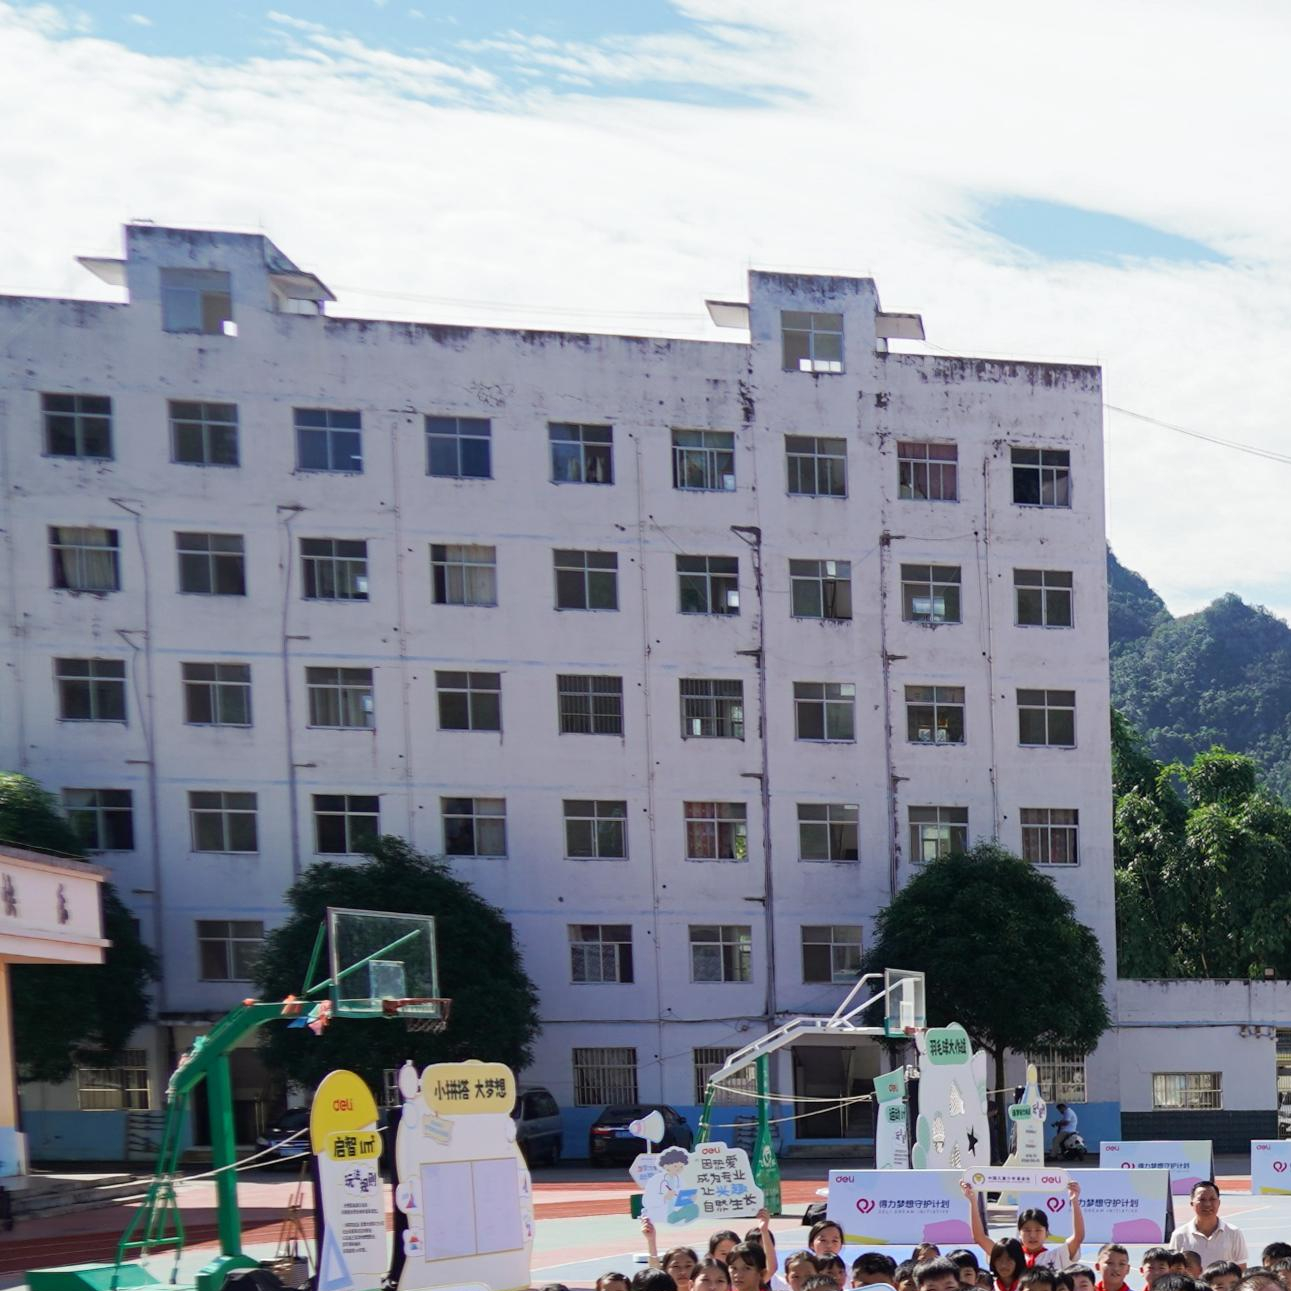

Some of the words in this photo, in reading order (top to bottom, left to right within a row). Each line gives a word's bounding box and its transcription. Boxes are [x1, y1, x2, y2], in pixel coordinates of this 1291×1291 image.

[475, 1078, 506, 1098] 大梦想
[333, 1099, 353, 1112] deli
[836, 1175, 854, 1184] deli
[1042, 1176, 1061, 1184] deli
[704, 1193, 757, 1213] 自然生长
[879, 1199, 949, 1210] 得力梦想守护计划
[1069, 1198, 1139, 1209] 力梦想守护计划
